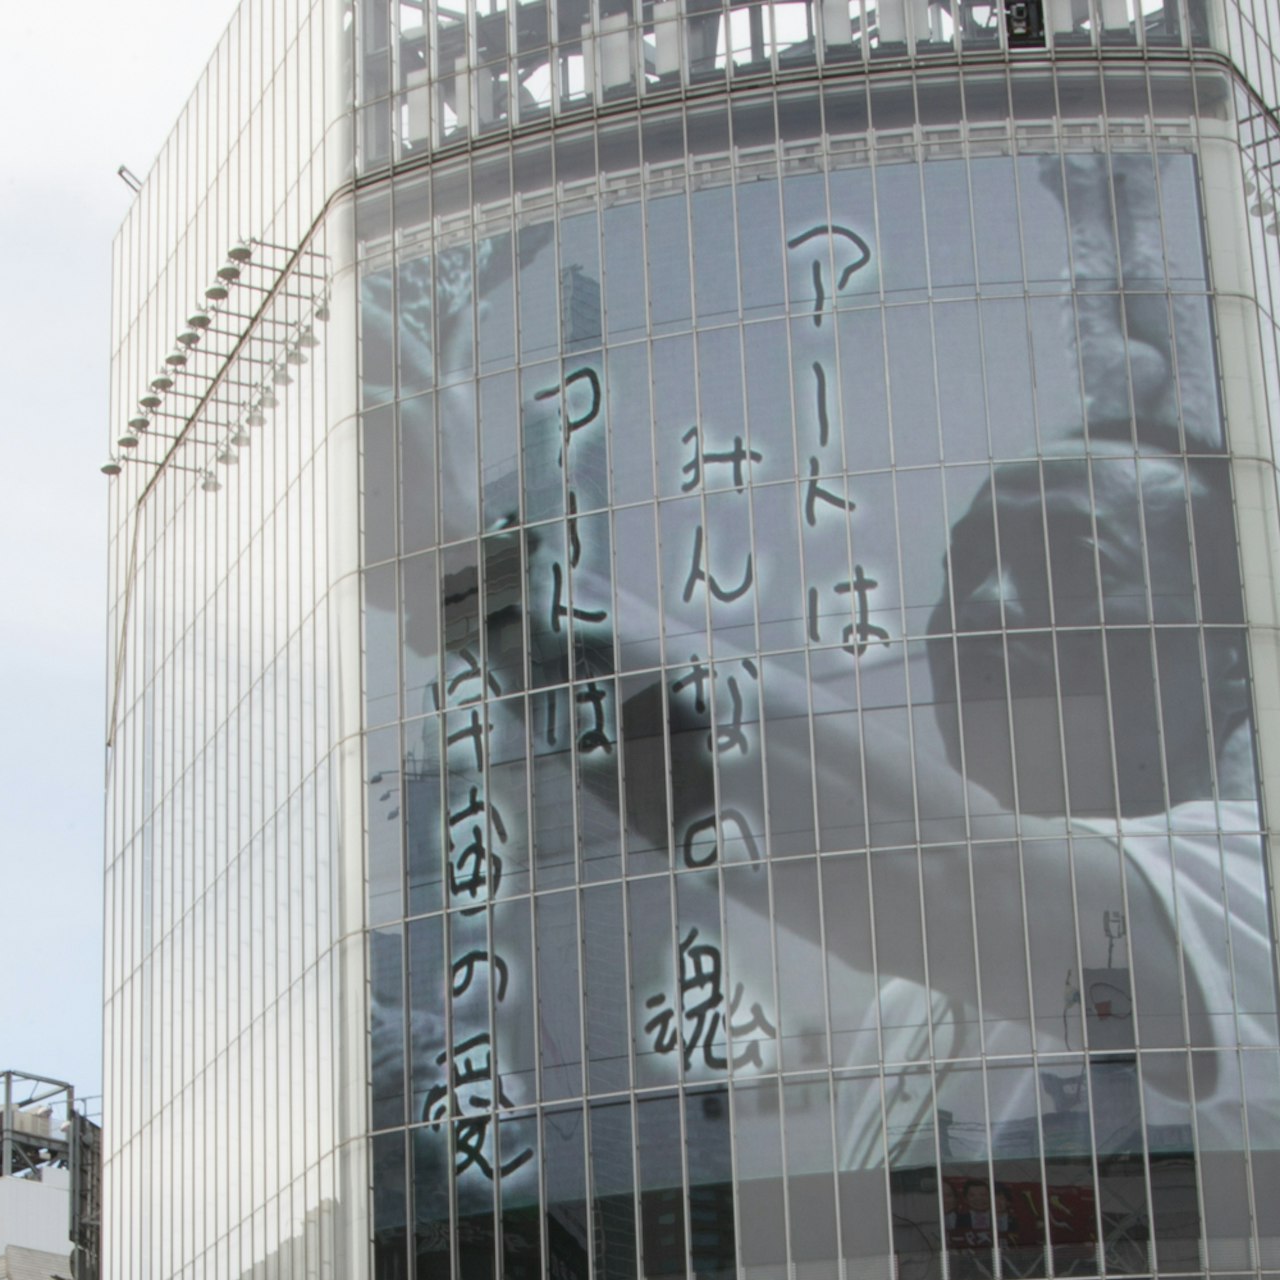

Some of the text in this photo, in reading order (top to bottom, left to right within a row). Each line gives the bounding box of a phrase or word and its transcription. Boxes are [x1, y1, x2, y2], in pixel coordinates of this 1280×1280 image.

[787, 225, 890, 658] アートは
[645, 424, 776, 1073] みんなの魂
